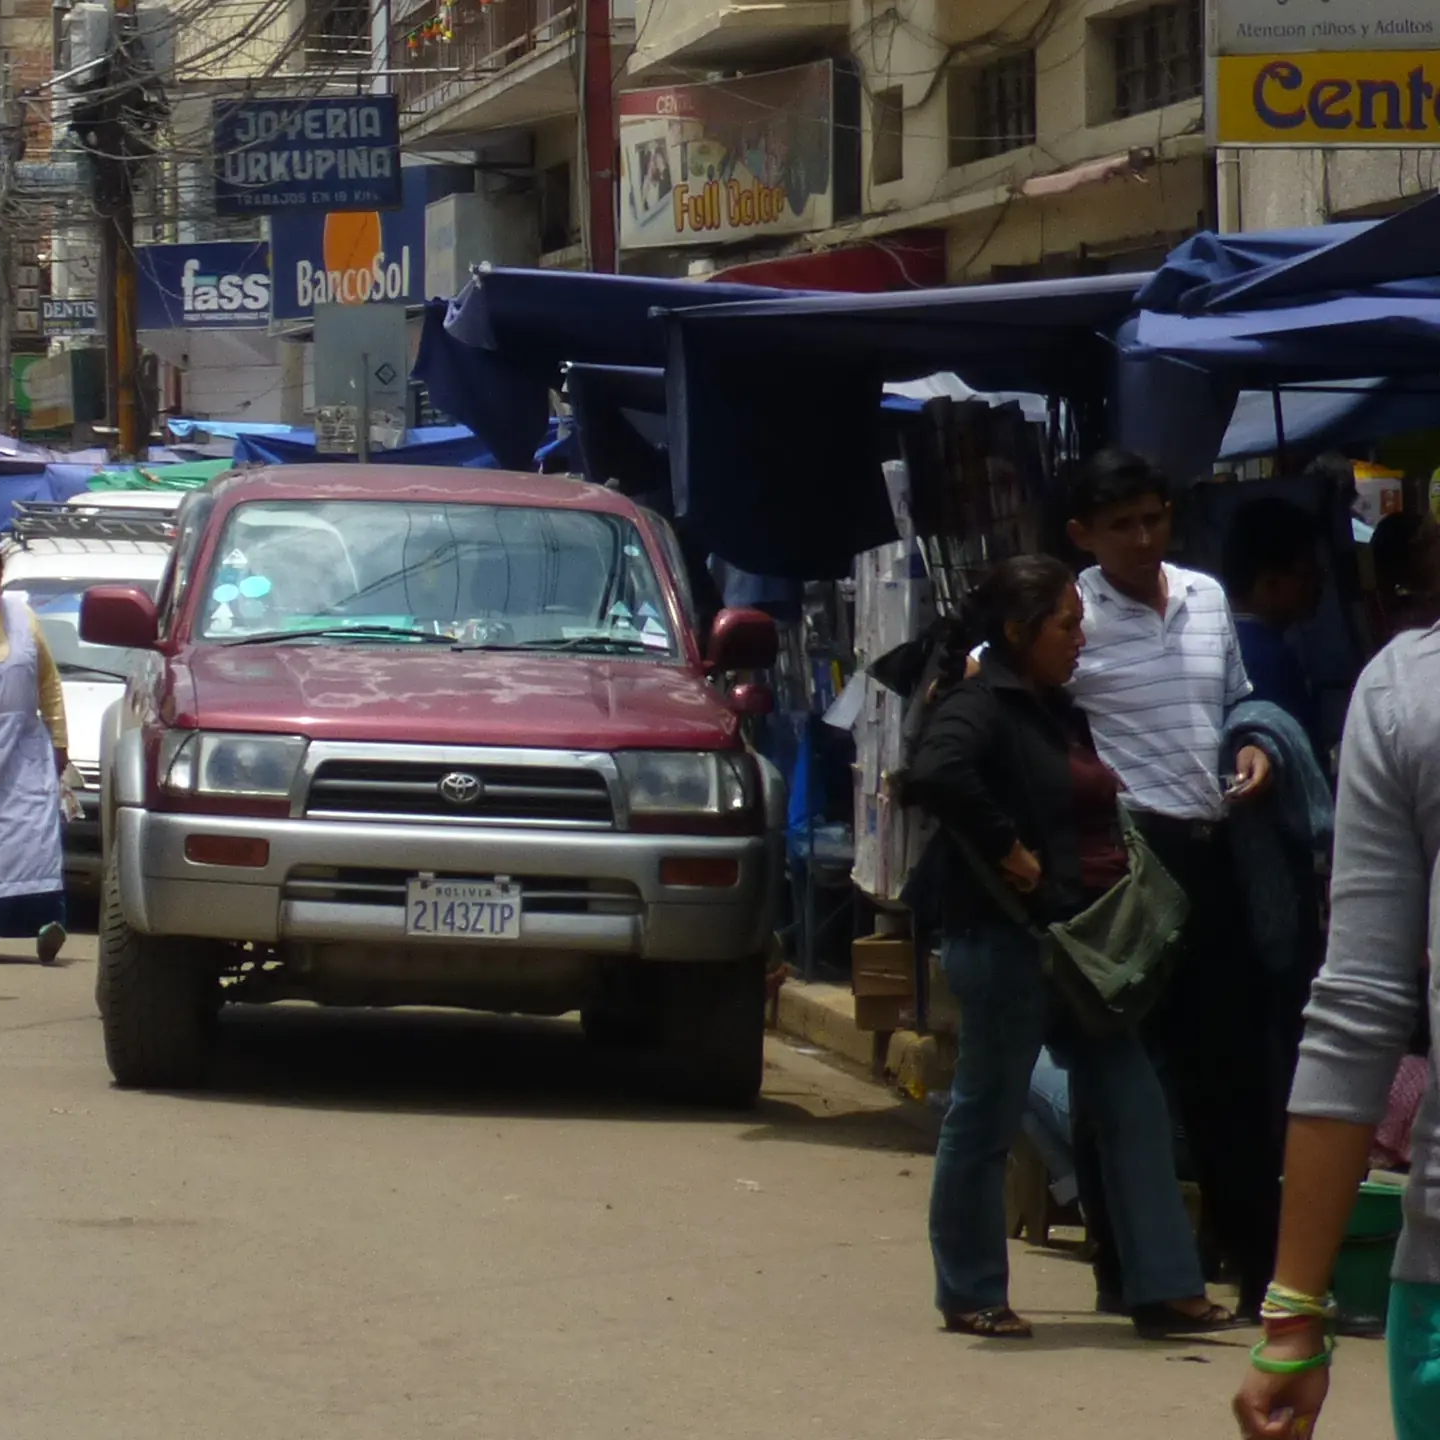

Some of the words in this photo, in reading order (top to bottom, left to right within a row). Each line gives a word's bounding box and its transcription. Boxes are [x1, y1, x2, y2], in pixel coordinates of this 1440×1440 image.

[1361, 25, 1369, 39] y
[1374, 18, 1434, 35] Adultos
[1252, 60, 1440, 131] Cent
[234, 106, 382, 142] JOYERIA
[223, 145, 393, 183] URKUPIÑA
[236, 192, 307, 206] TRABAJOS
[673, 180, 720, 232] Full
[181, 258, 270, 311] fass
[296, 246, 410, 307] BancoSol
[435, 887, 492, 897] BOLIVIA
[413, 900, 514, 933] 2143ZTP
